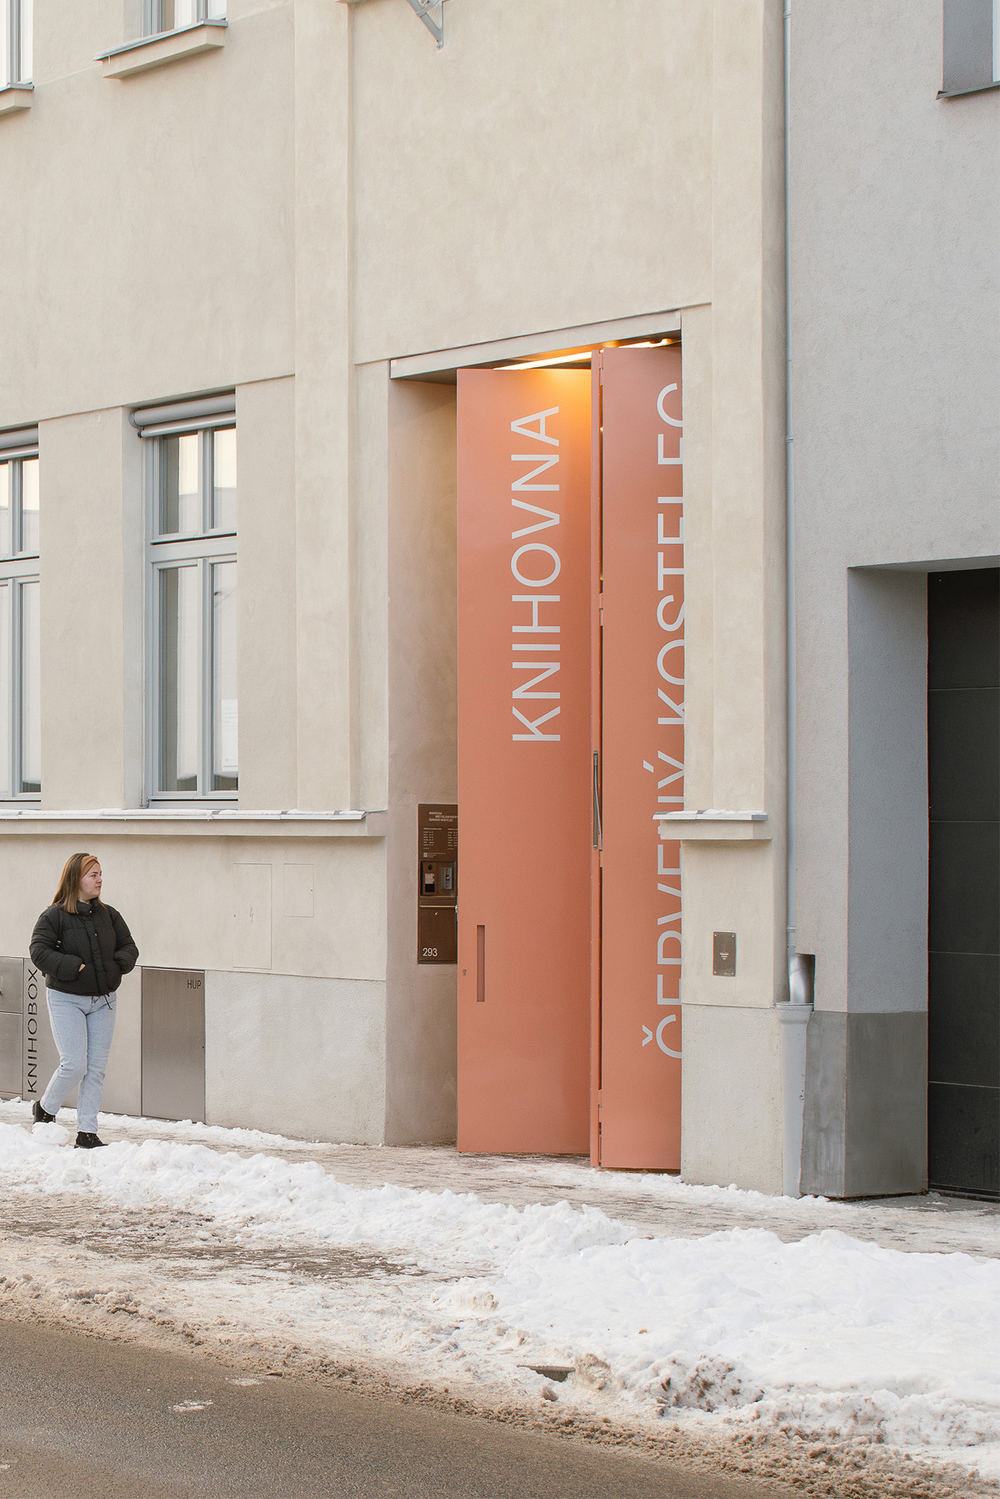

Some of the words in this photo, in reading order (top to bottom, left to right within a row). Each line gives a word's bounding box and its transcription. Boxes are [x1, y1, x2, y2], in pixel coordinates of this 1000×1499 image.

[510, 405, 562, 742] KNIHOVNA
[422, 947, 438, 957] 293
[641, 750, 685, 1059] ČERVEÝ
[27, 968, 38, 1094] KNIHOBOX
[186, 979, 202, 990] HUP
